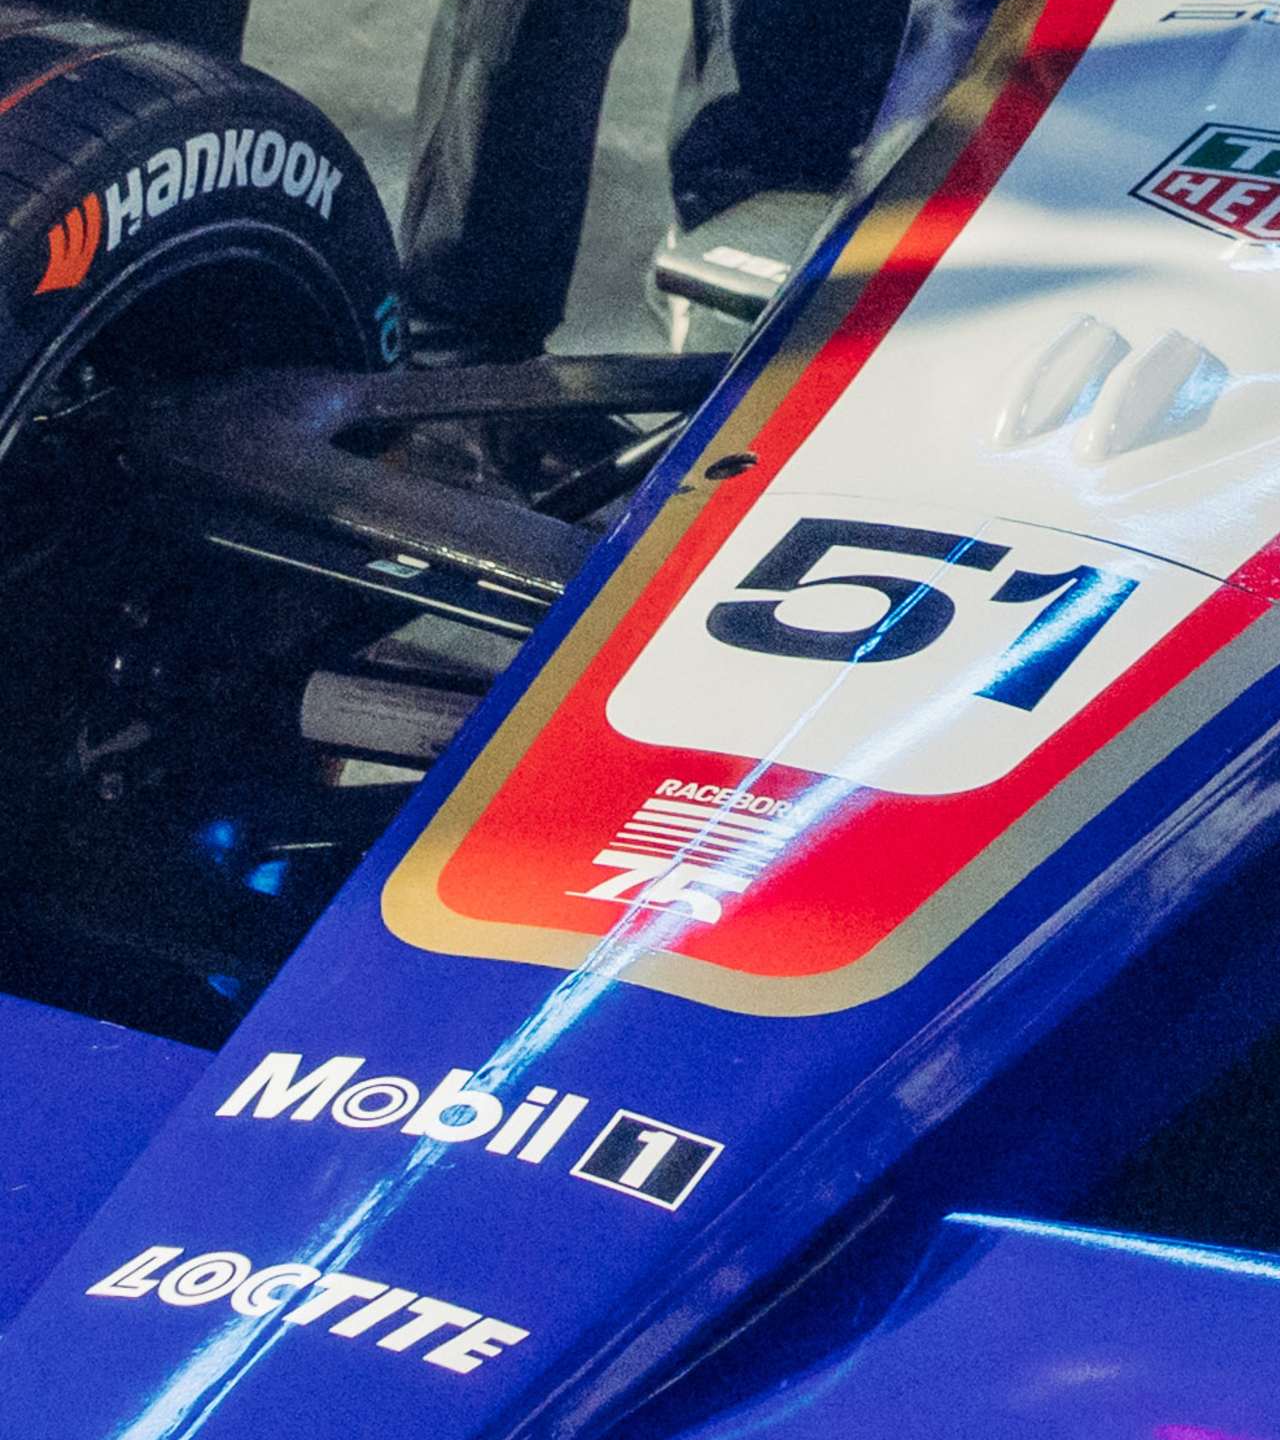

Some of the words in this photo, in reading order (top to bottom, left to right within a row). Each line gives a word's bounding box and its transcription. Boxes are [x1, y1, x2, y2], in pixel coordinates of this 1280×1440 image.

[706, 517, 1140, 712] 51
[655, 778, 794, 818] RACEBOR
[215, 1051, 590, 1165] Mobil
[86, 1244, 531, 1375] LOCTITE
